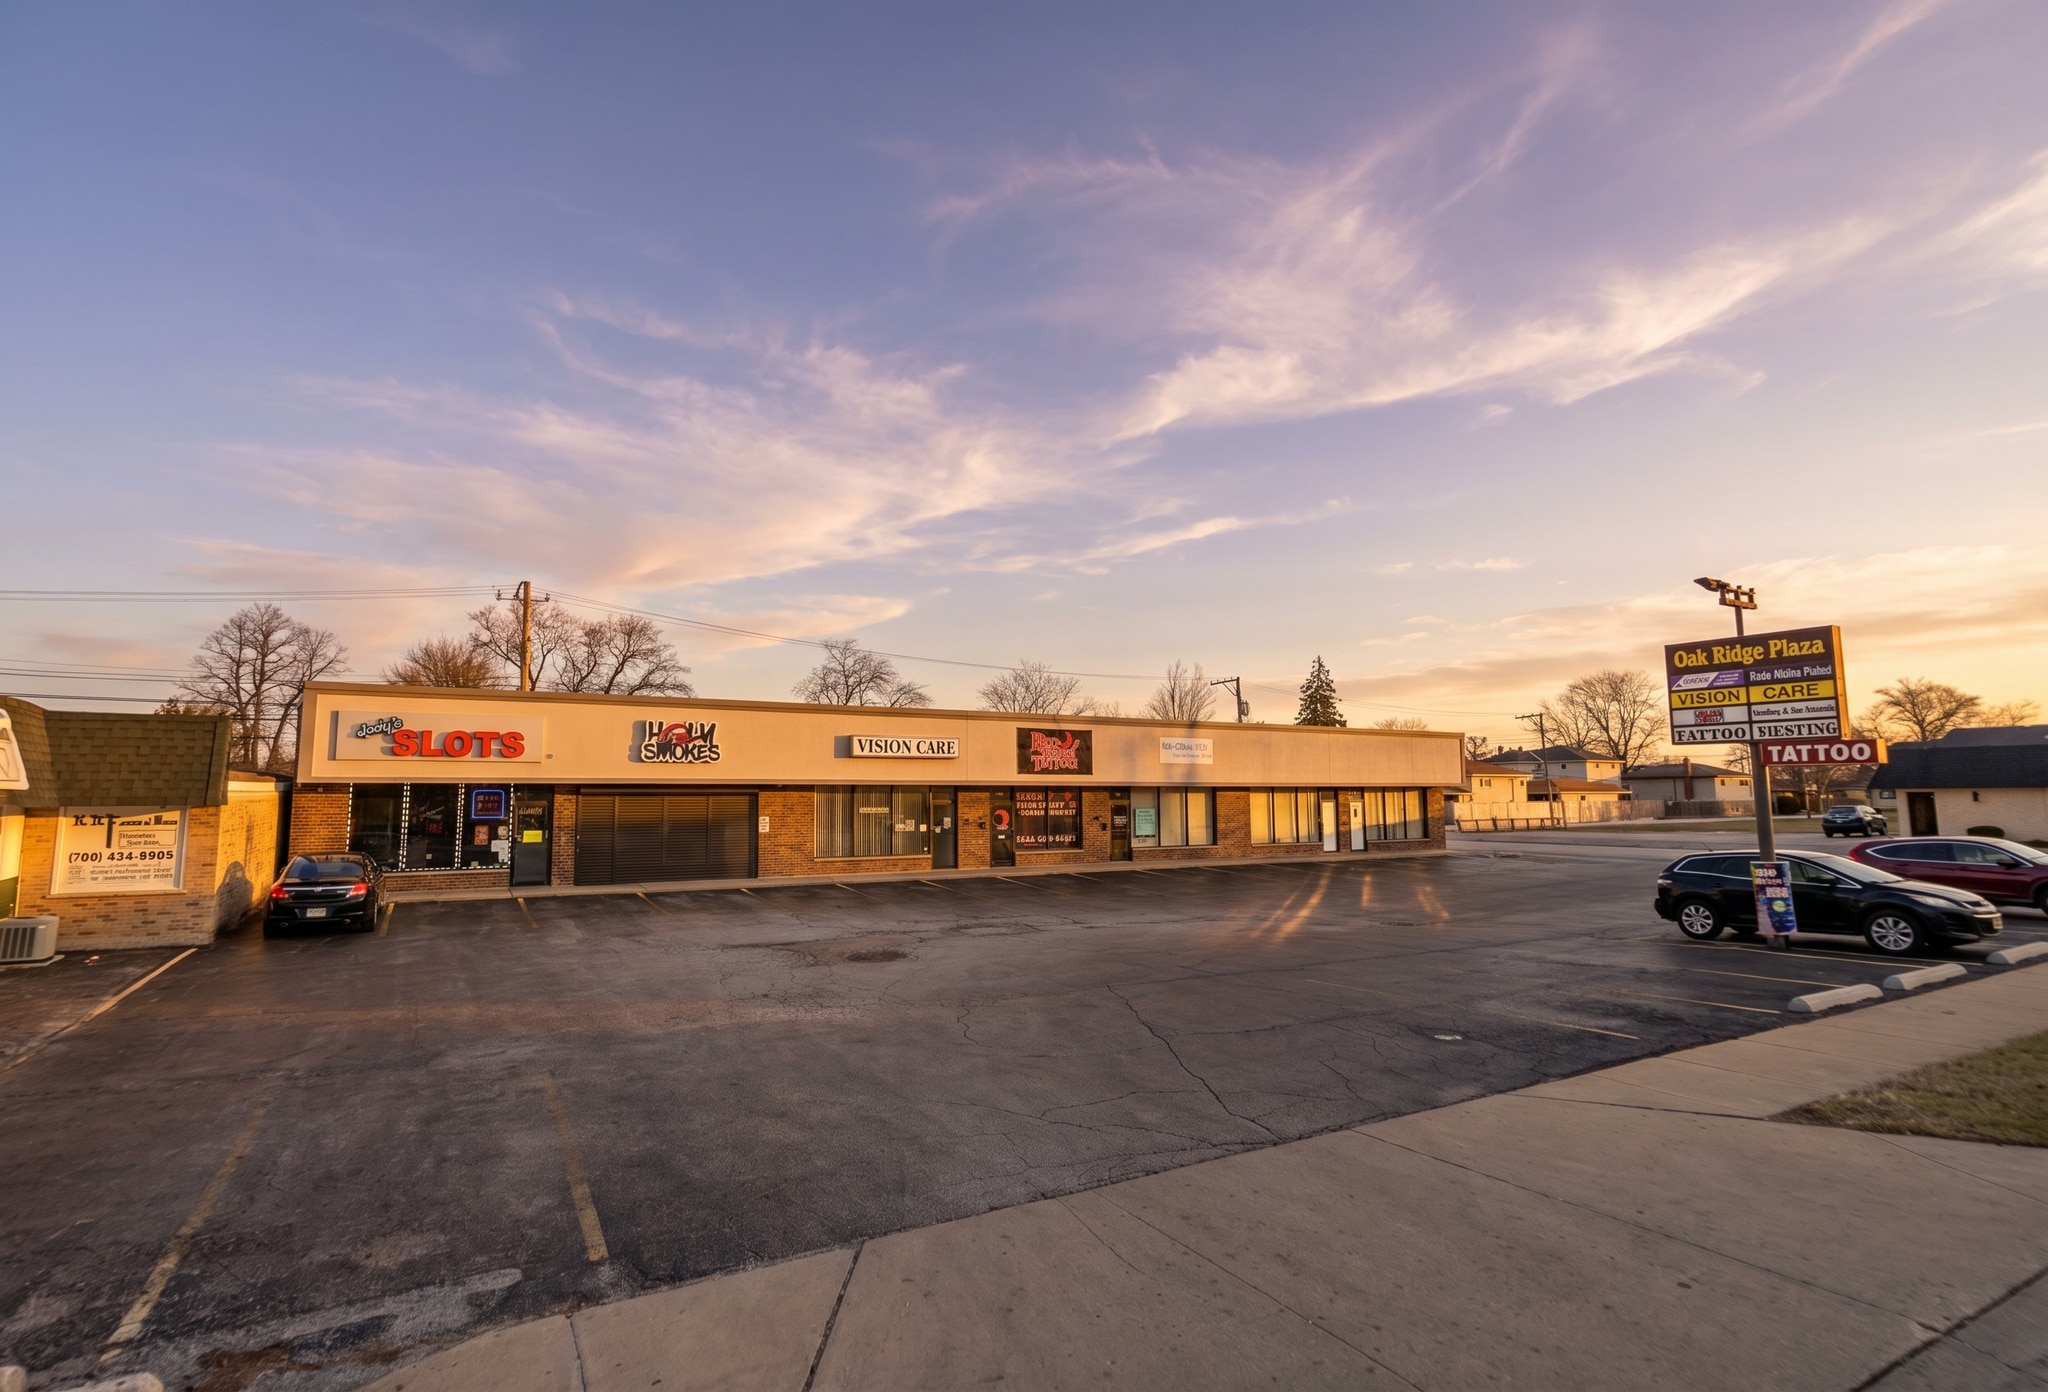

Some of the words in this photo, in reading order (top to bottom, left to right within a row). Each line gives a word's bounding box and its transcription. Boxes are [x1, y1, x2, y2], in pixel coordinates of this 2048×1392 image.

[1673, 650, 1709, 668] Oak
[1711, 644, 1764, 665] Ridge
[1768, 638, 1825, 658] Plaza
[1677, 689, 1740, 706] VISION
[1763, 683, 1819, 699] CARE
[391, 729, 525, 758] SLOTS
[641, 742, 721, 761] SMOKES
[857, 738, 912, 754] VISION
[916, 740, 956, 755] CARE
[1767, 743, 1871, 762] TATTOO
[68, 852, 103, 863] (700)
